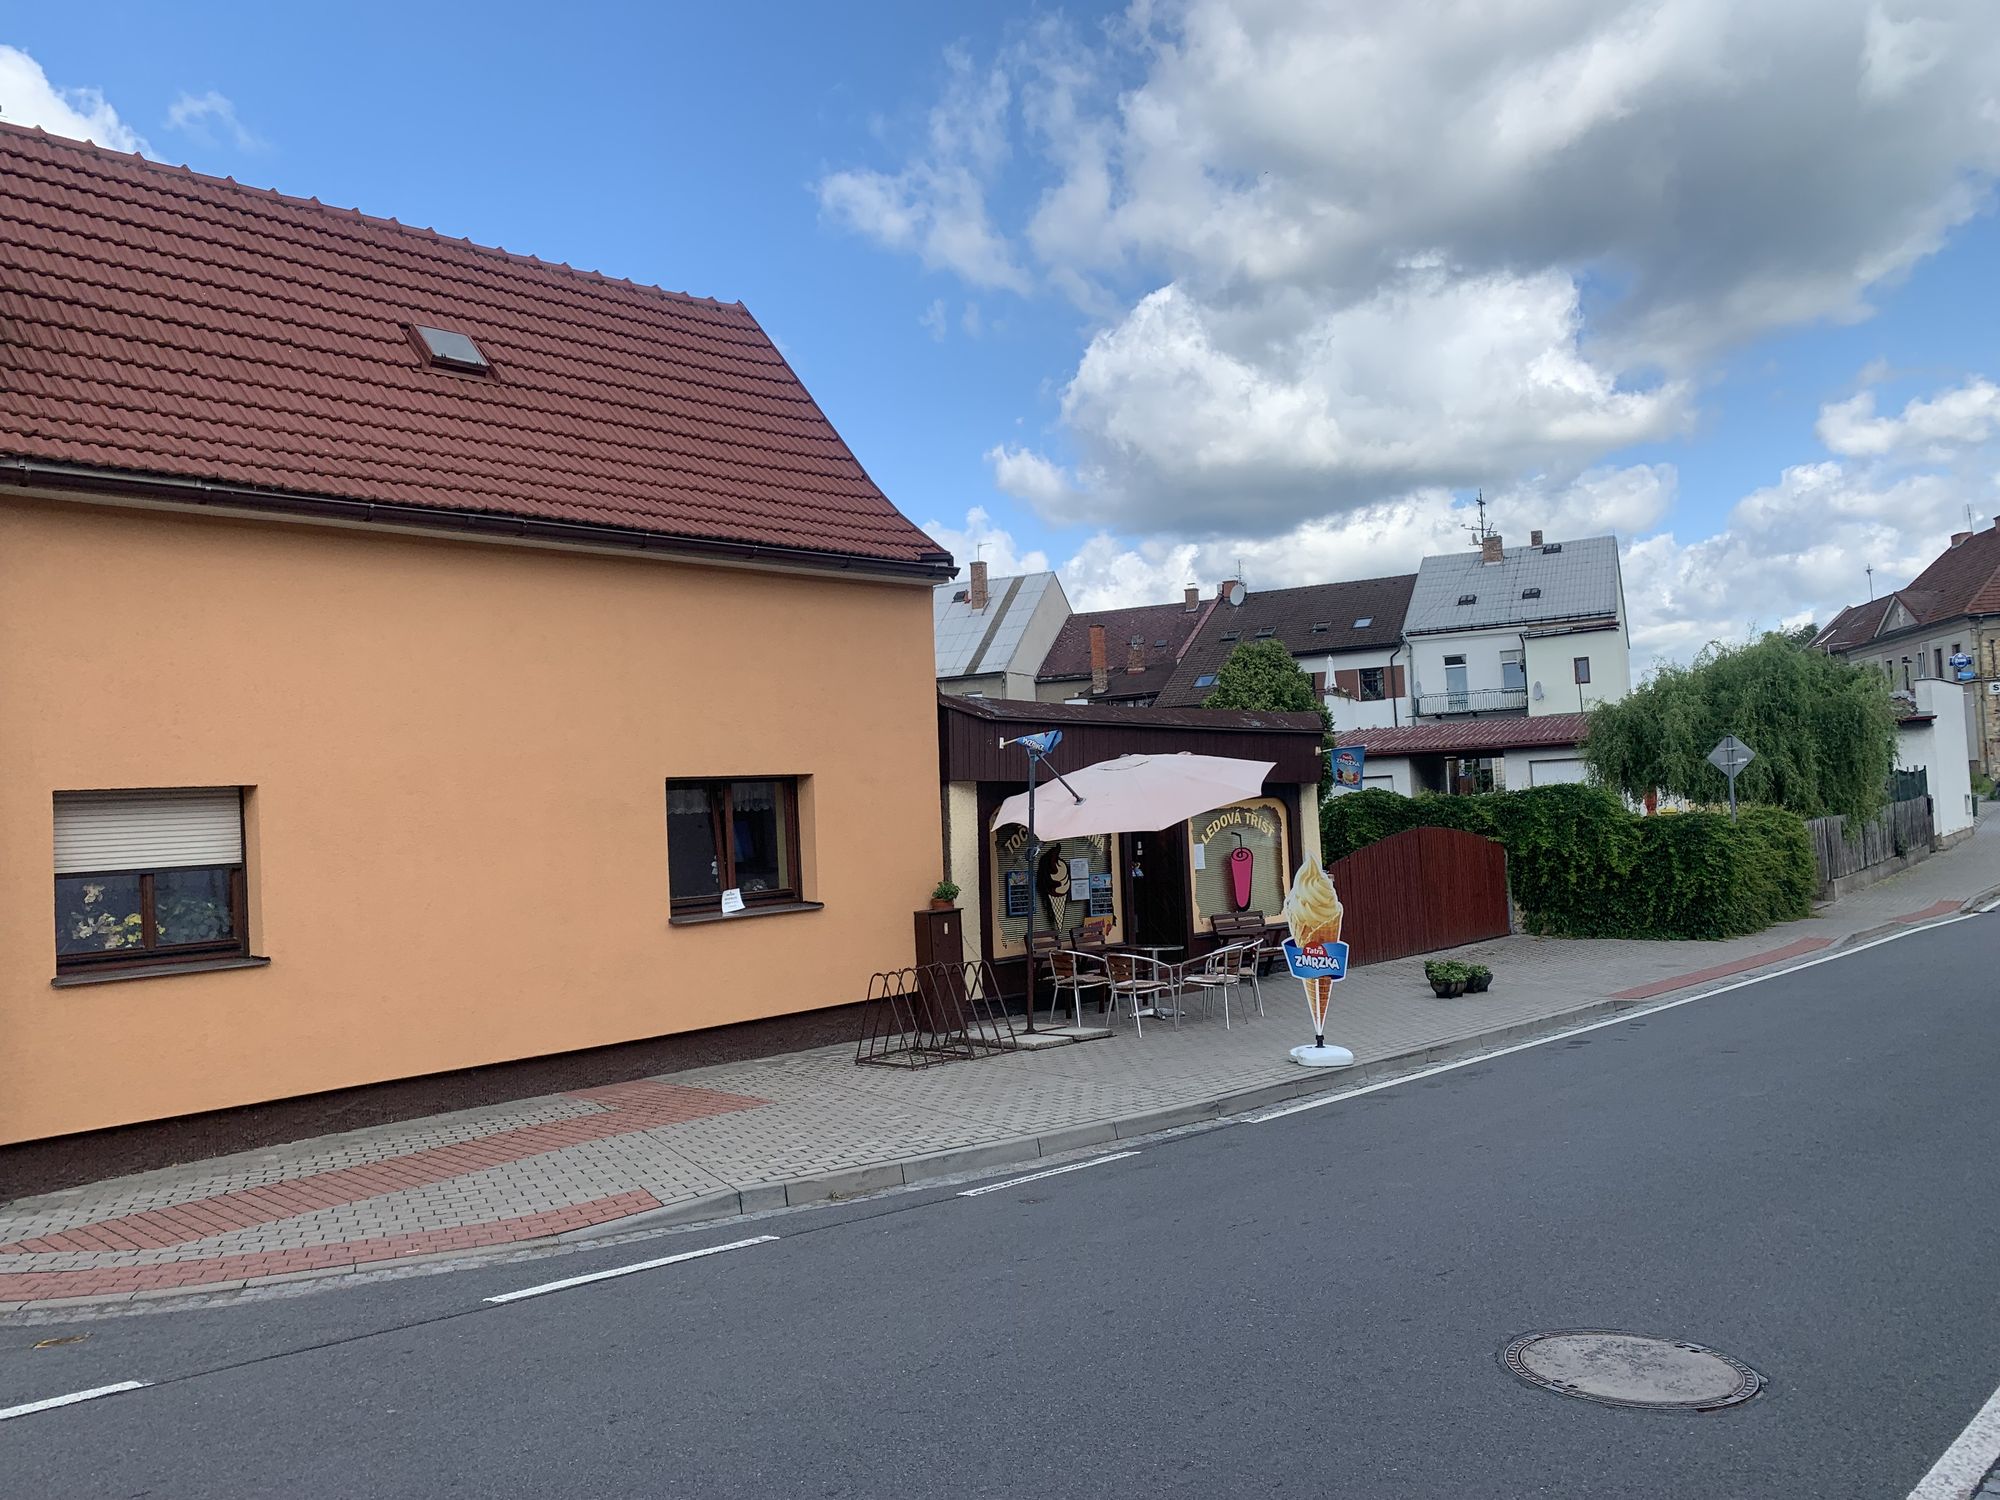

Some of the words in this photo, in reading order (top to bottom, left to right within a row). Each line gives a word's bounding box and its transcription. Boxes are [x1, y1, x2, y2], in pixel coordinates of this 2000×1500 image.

[1004, 825, 1029, 854] TOČ
[1200, 809, 1242, 845] LEDOVÁ
[1244, 811, 1276, 838] TŘÍŠŤ
[1294, 954, 1340, 970] ZMRZKA
